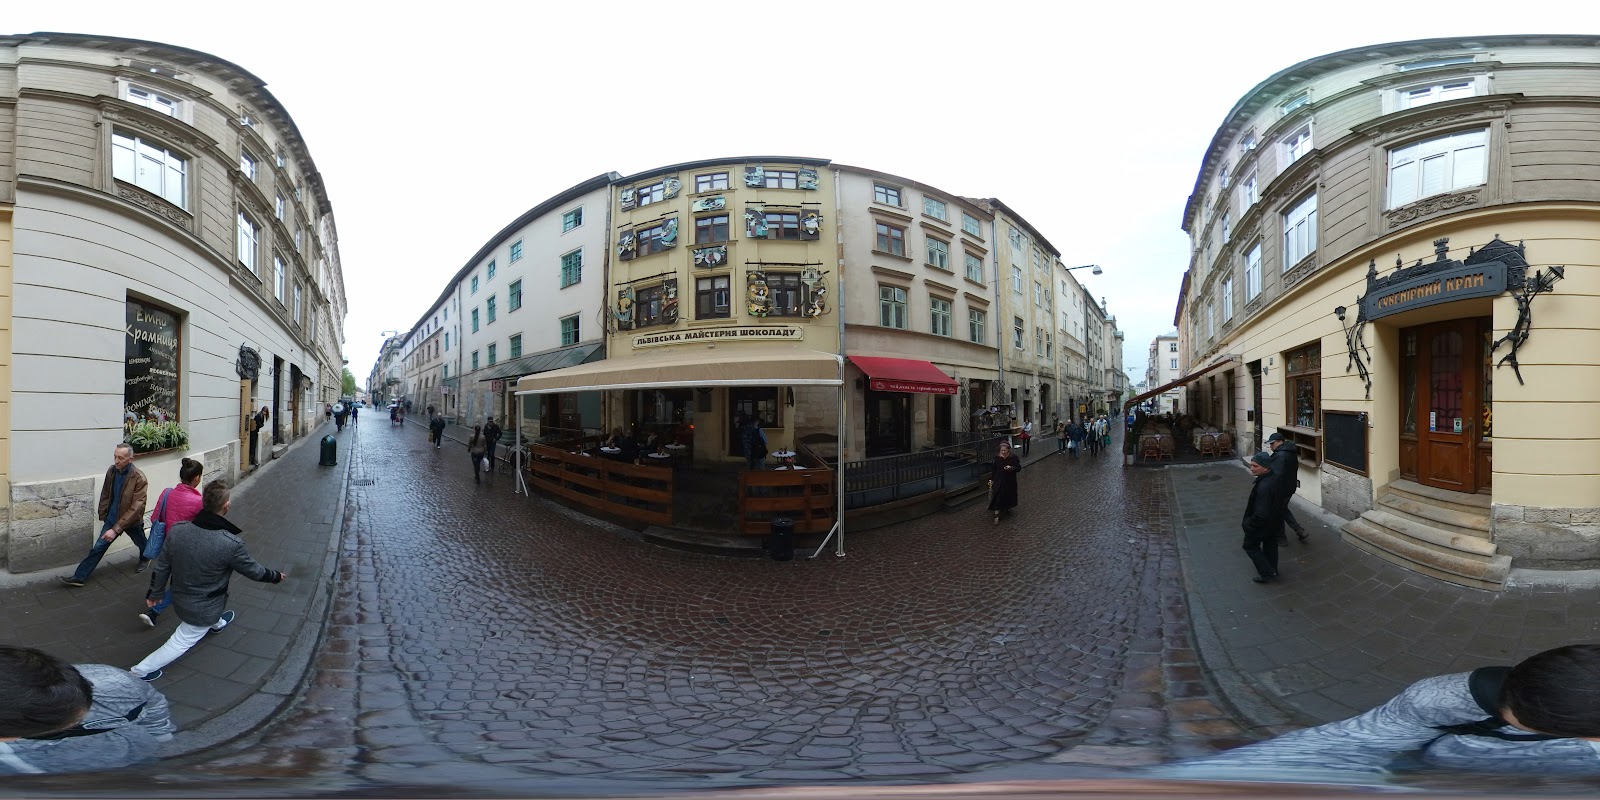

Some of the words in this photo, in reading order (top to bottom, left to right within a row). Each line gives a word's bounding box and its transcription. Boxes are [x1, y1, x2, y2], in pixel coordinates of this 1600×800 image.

[1378, 279, 1441, 309] СУВЕНІРНИЙ
[1446, 272, 1484, 292] КРАМ
[636, 333, 681, 345] ЛЬВІВСЬКА
[684, 330, 737, 340] МАЙСТЕРНЯ
[739, 329, 796, 337] ШОКОЛАДУ
